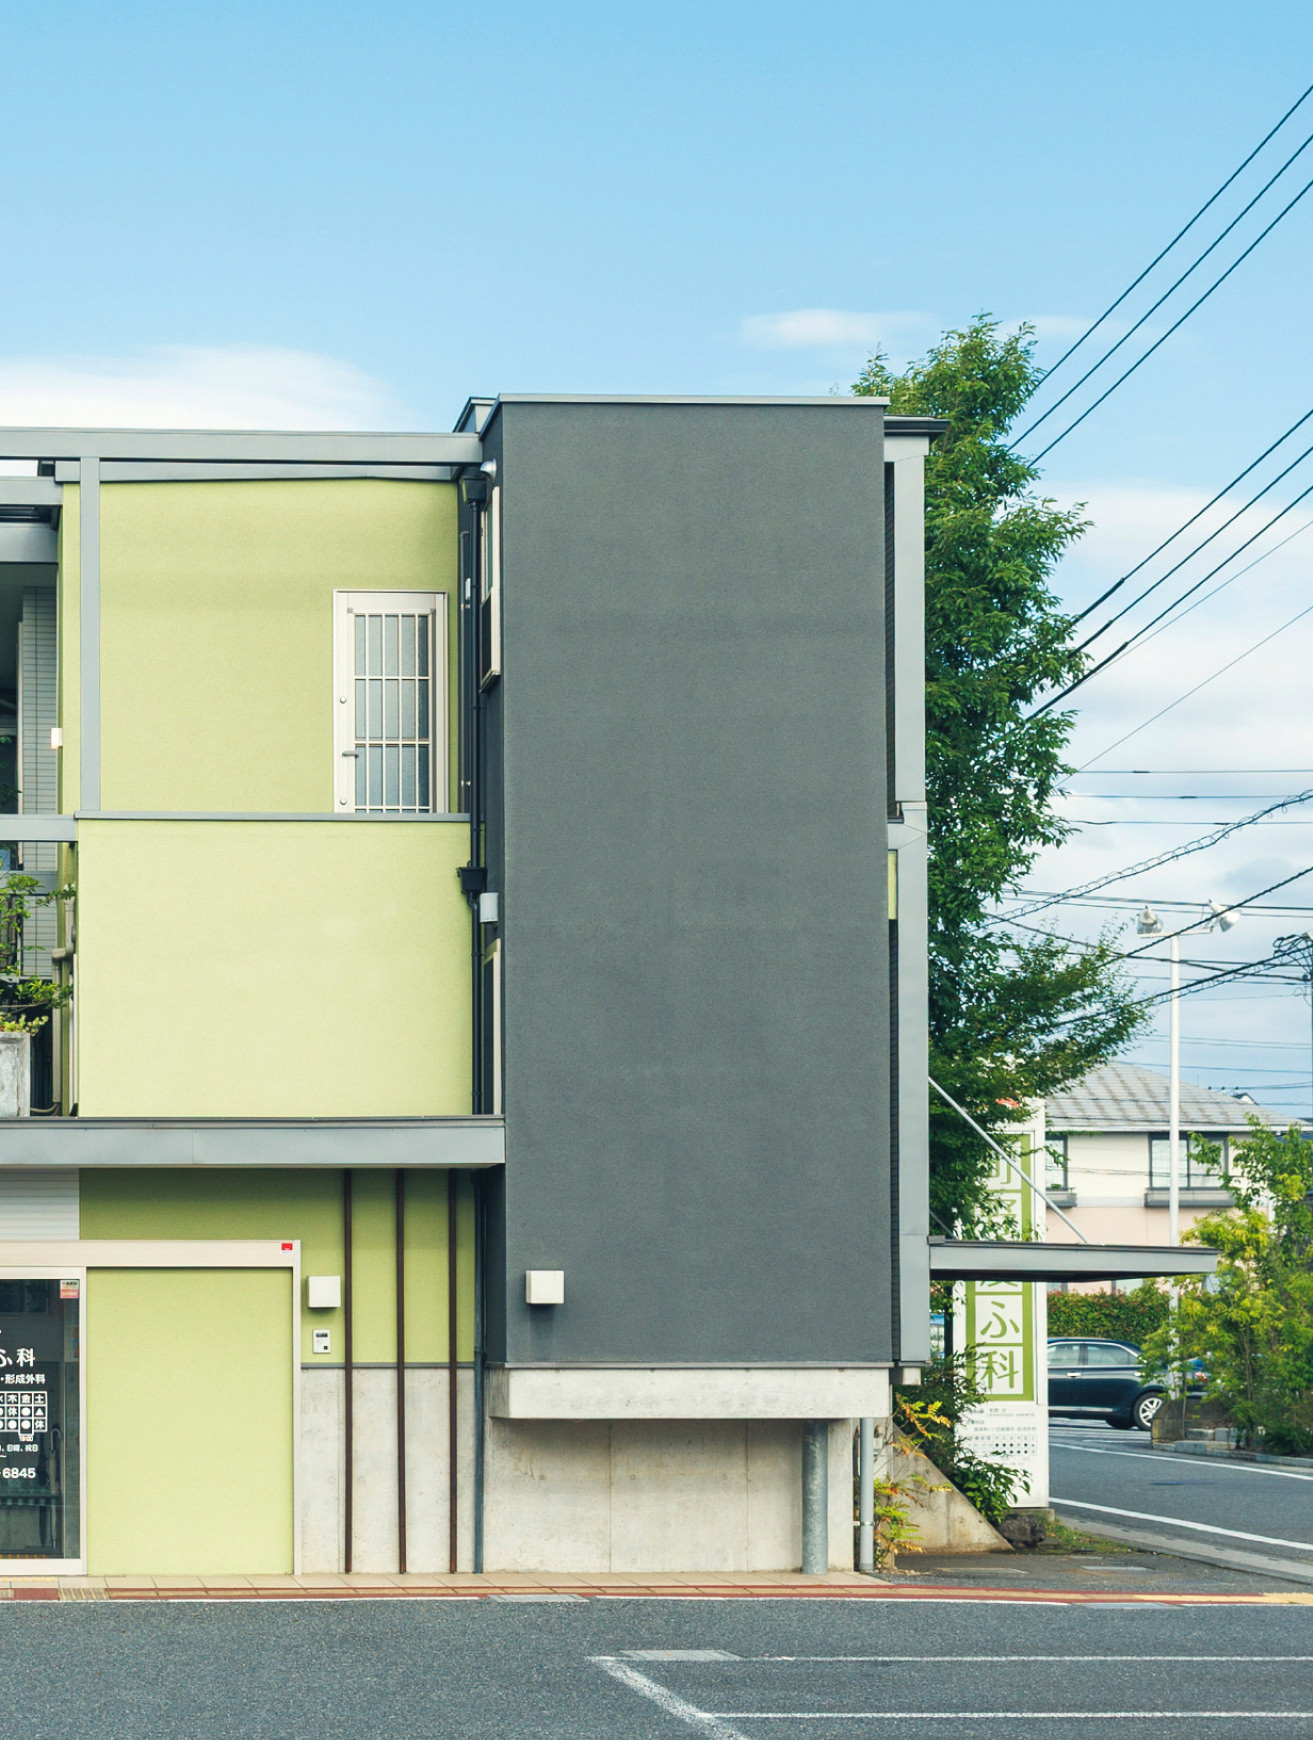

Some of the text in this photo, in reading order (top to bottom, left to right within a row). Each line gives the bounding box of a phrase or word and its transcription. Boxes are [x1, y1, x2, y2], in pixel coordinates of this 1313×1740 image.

[7, 1394, 18, 1404] 木
[21, 1394, 31, 1404] 金
[34, 1394, 44, 1404] 土
[8, 1407, 18, 1416] 休
[35, 1420, 45, 1429] 休
